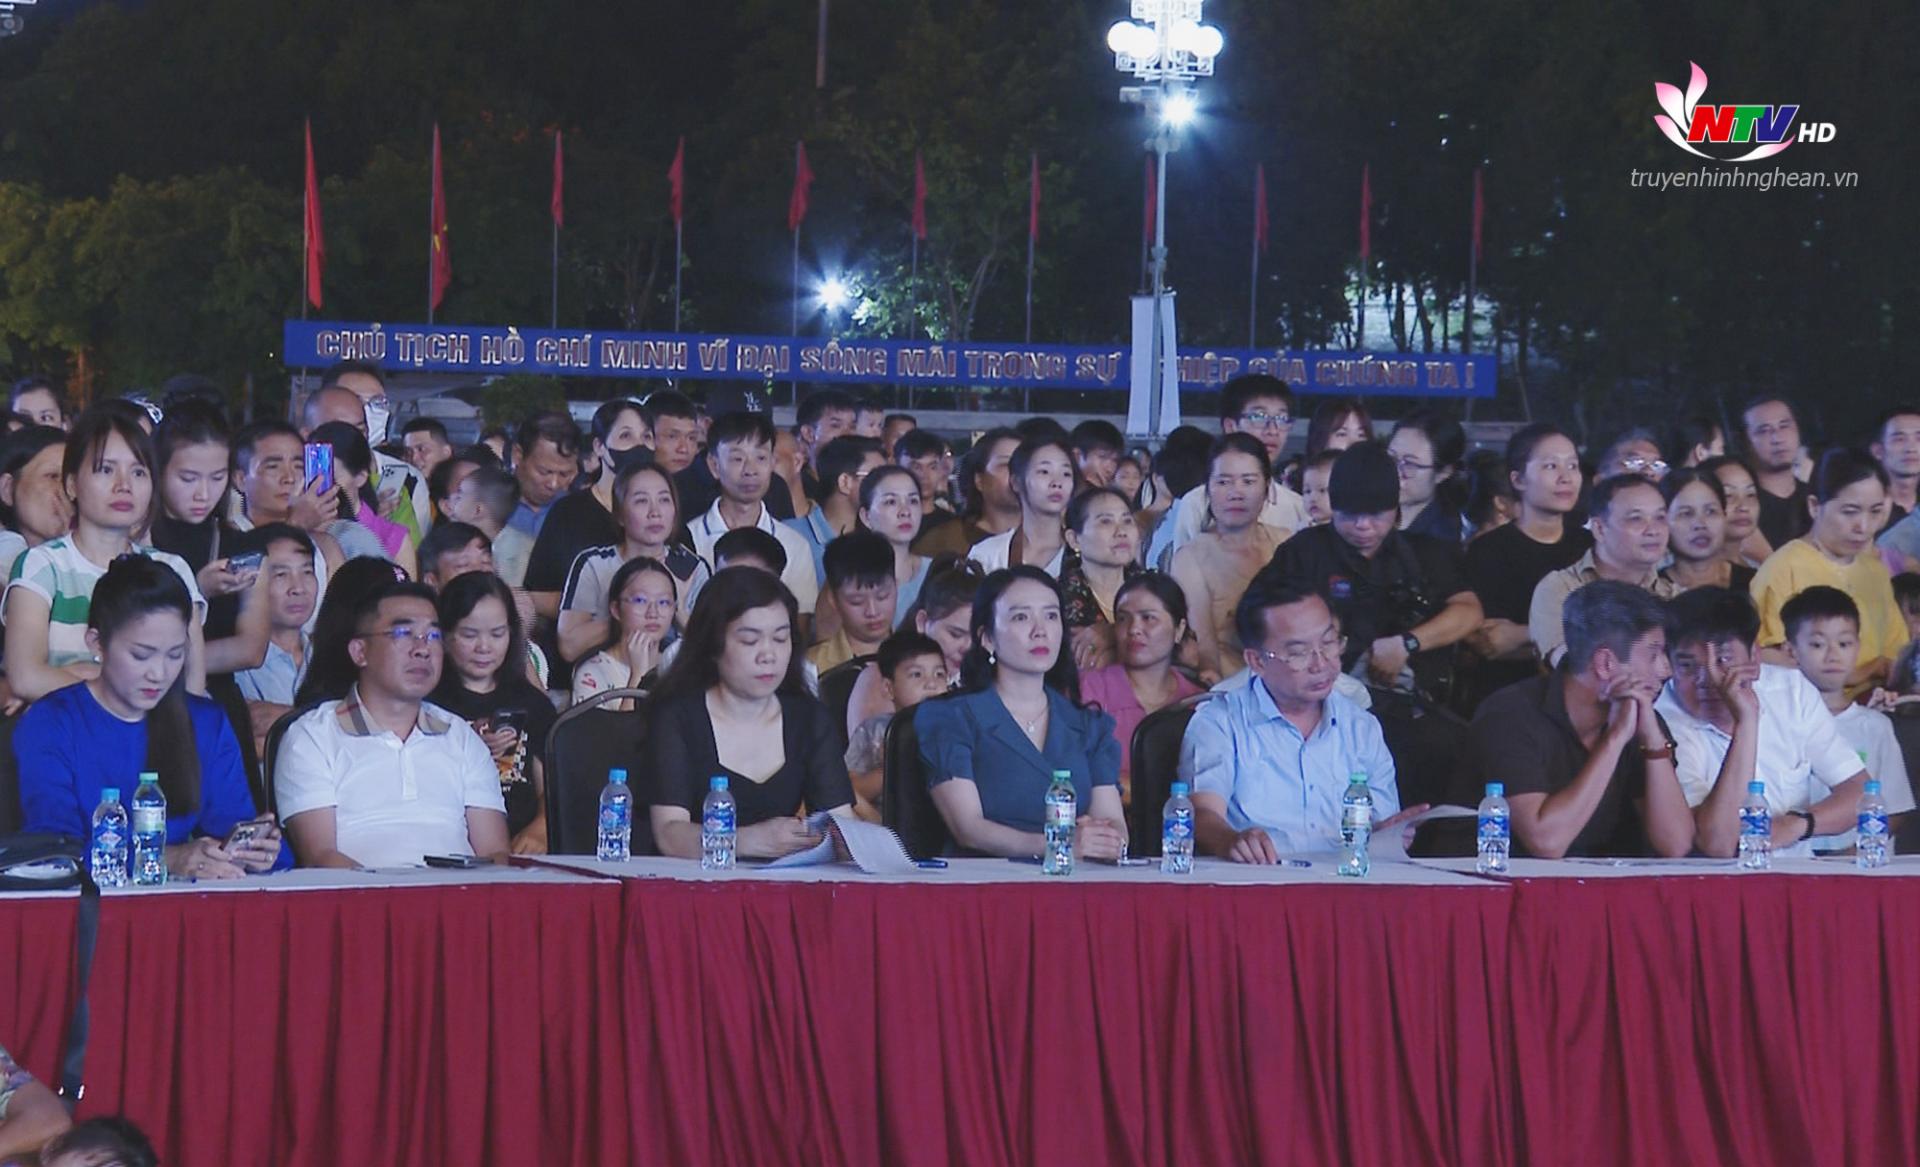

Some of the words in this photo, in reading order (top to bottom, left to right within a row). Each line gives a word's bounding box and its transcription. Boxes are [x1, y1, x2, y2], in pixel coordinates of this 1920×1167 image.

[316, 322, 386, 360] CHỦ
[394, 332, 470, 367] TỊCH
[480, 326, 526, 365] HỒ
[535, 334, 592, 367] CHÍ
[601, 339, 688, 370] MINH
[699, 338, 730, 372] VĨ
[735, 344, 790, 378] ĐẠI
[897, 345, 957, 378] MÃI
[964, 349, 1067, 380] TRONG
[1075, 351, 1122, 382] SỰ
[1316, 354, 1418, 387] CHÚNG
[1424, 361, 1460, 388] TA
